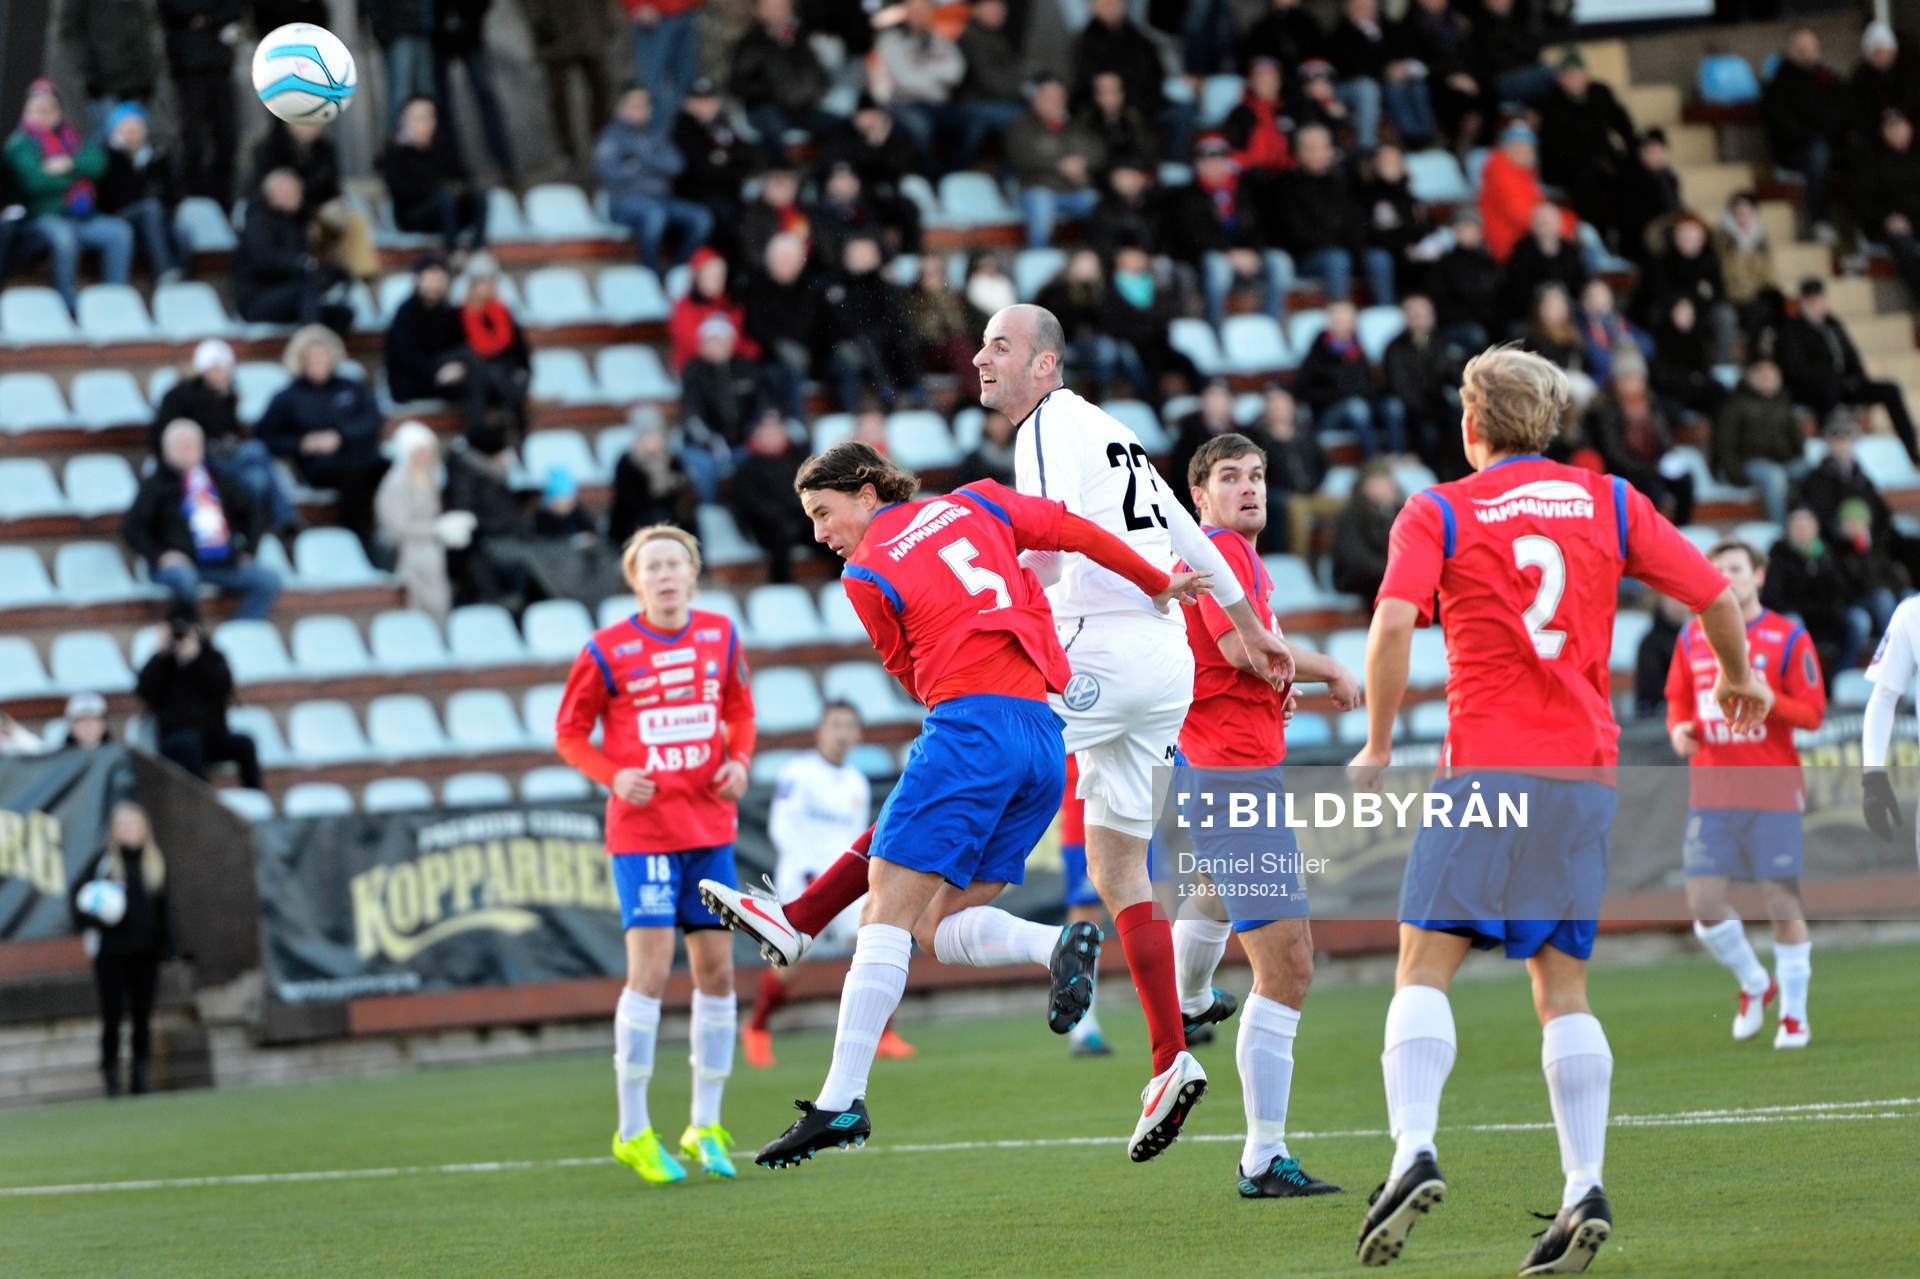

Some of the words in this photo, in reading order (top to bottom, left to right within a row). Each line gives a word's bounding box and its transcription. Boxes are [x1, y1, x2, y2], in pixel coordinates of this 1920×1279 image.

[1106, 442, 1169, 532] 23
[938, 537, 1012, 615] 5
[1512, 534, 1567, 659] 2
[646, 854, 671, 882] 18
